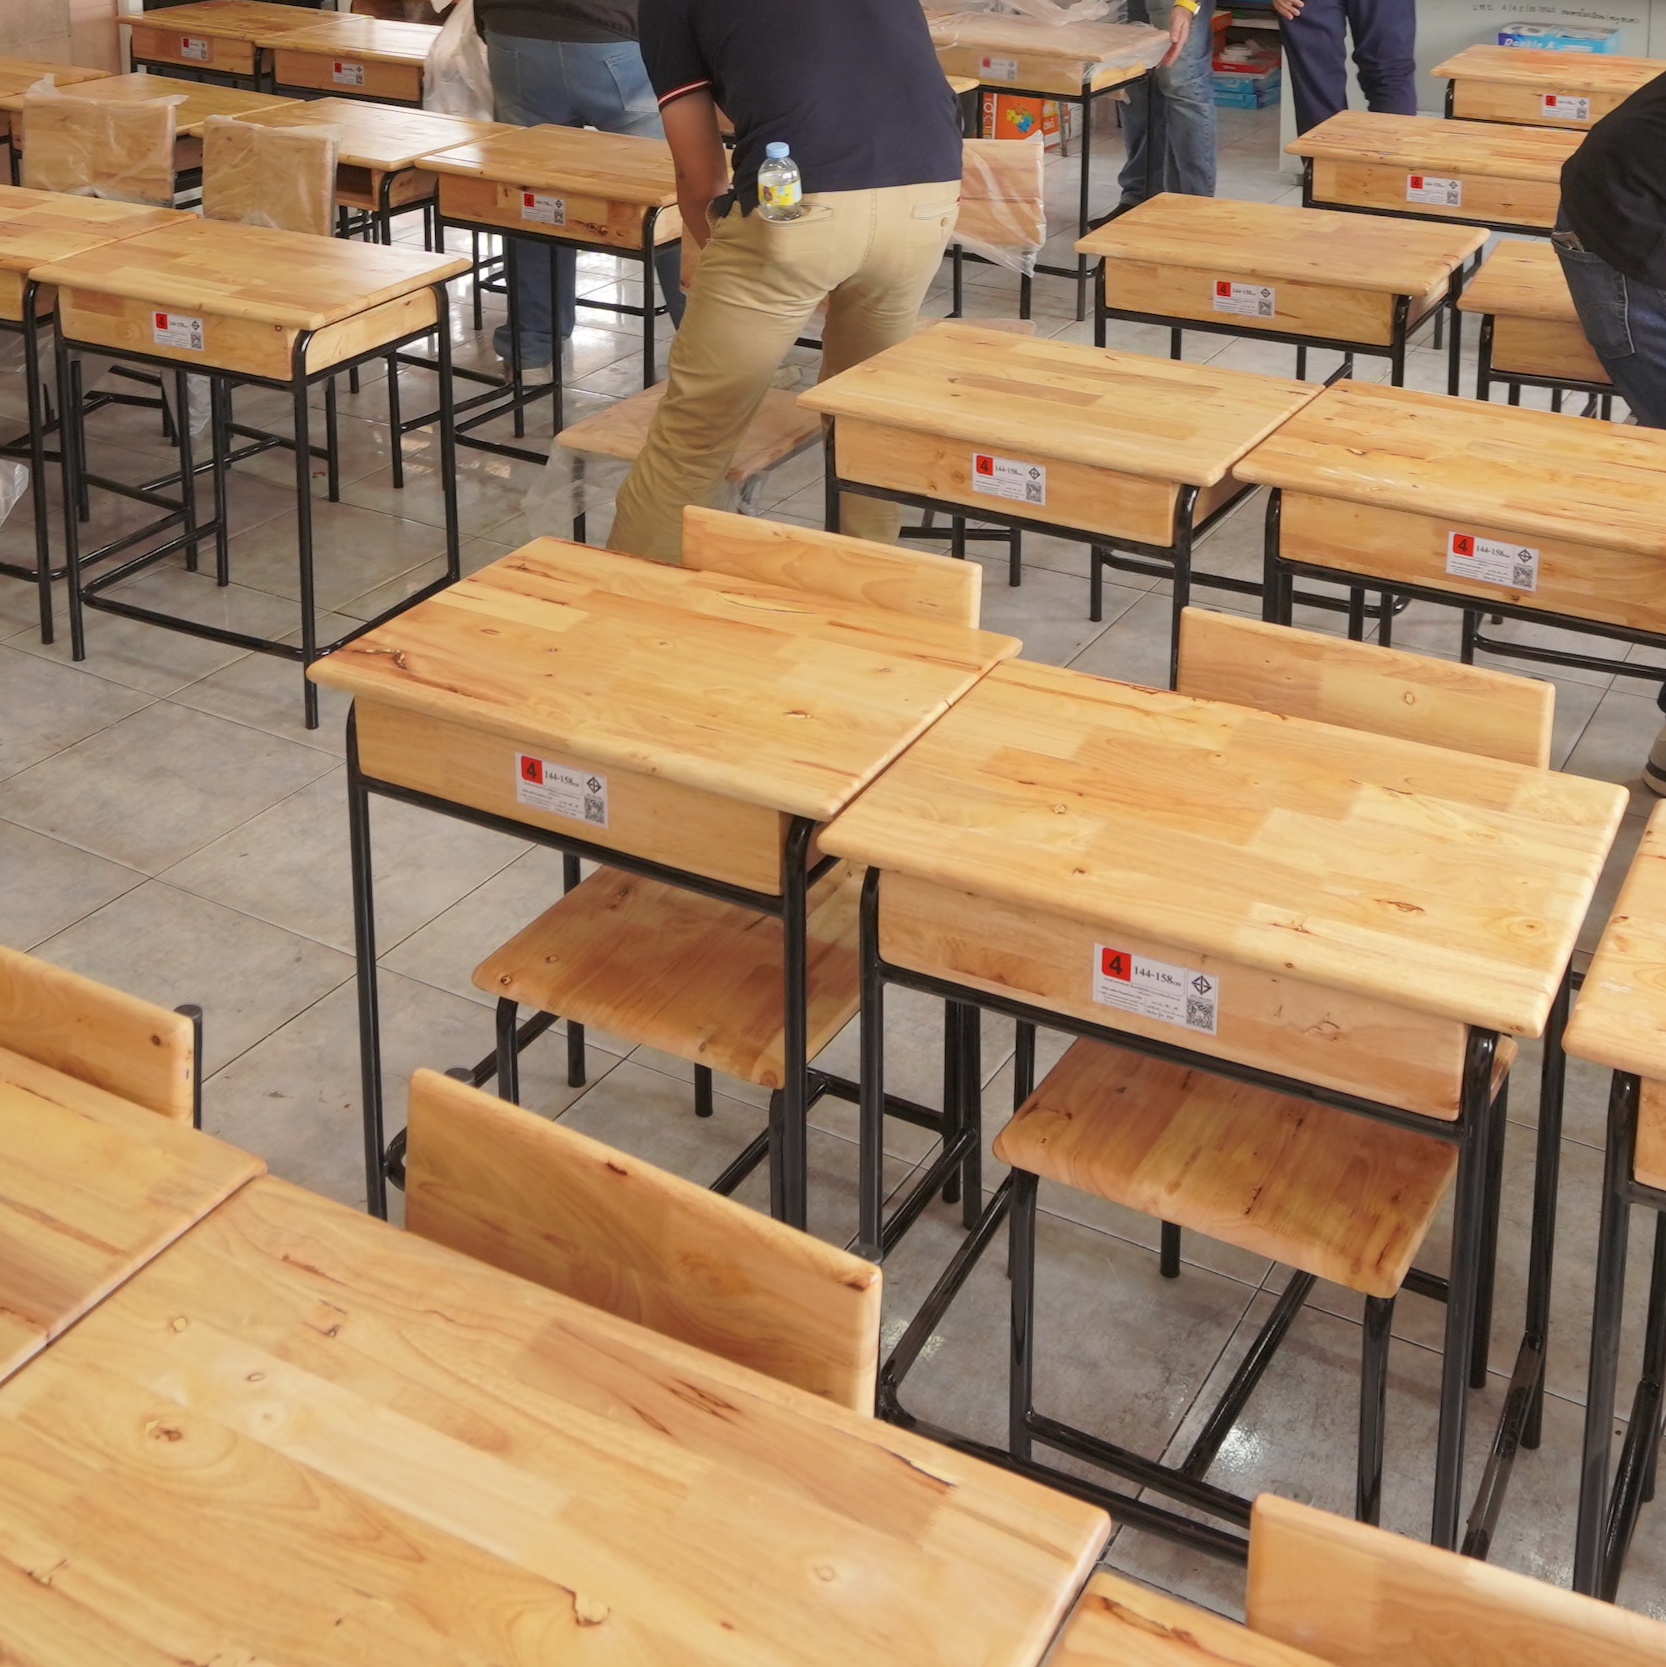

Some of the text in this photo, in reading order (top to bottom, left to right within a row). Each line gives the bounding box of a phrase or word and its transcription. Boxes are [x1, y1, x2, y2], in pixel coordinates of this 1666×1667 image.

[1232, 287, 1256, 297] 144-158
[980, 459, 989, 473] 4
[1457, 537, 1468, 553] 4
[527, 761, 537, 779] 4
[1108, 955, 1182, 988] 4 144-158cm
